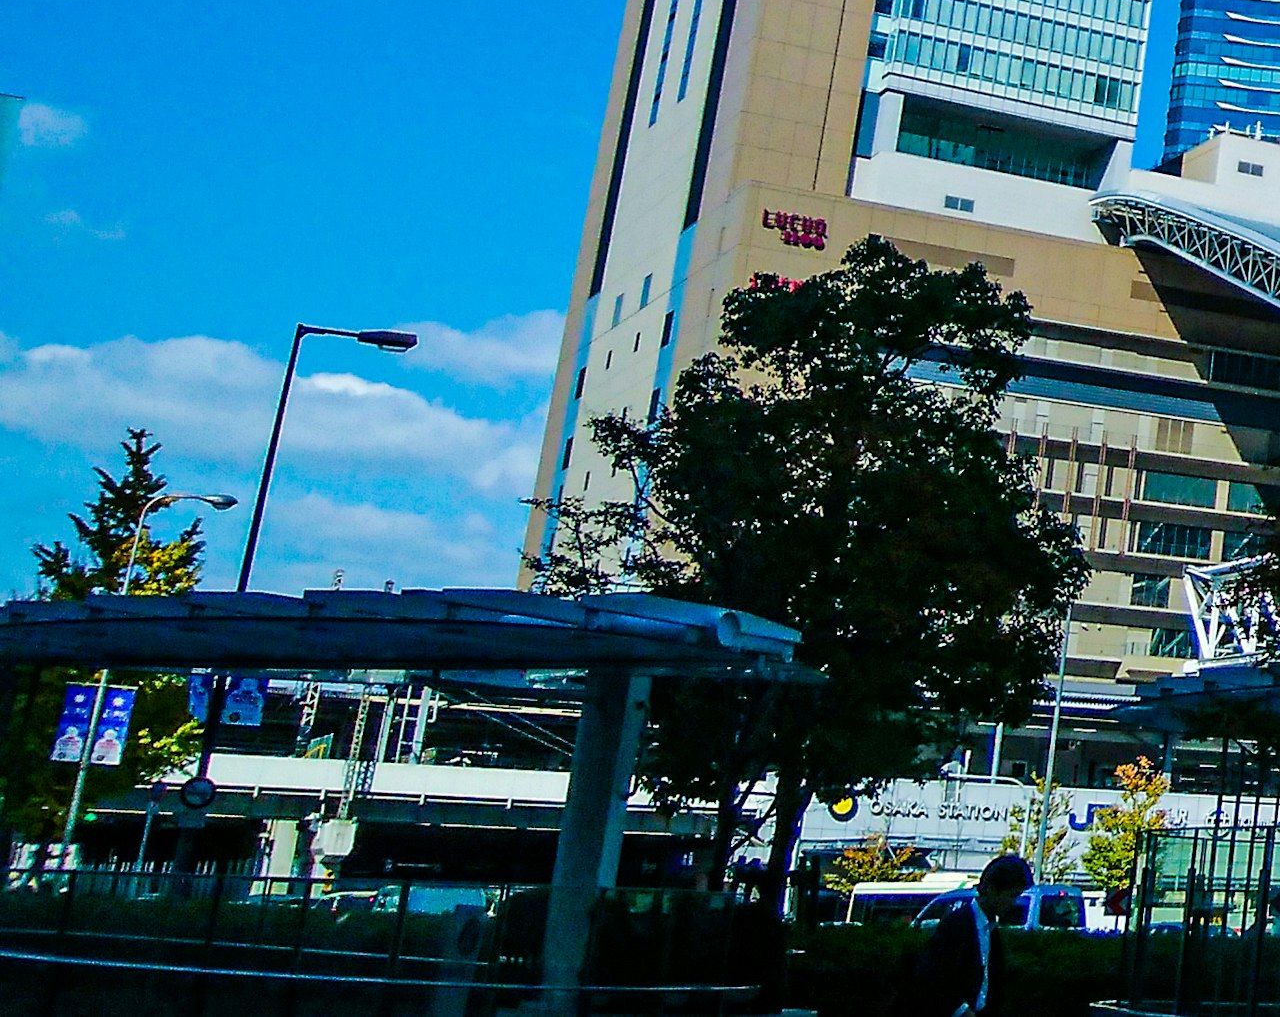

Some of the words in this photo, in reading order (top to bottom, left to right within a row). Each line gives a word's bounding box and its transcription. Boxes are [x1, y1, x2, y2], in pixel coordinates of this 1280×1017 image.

[762, 209, 828, 238] LUCUA
[869, 799, 929, 819] OSAKA
[938, 800, 1009, 822] STATION
